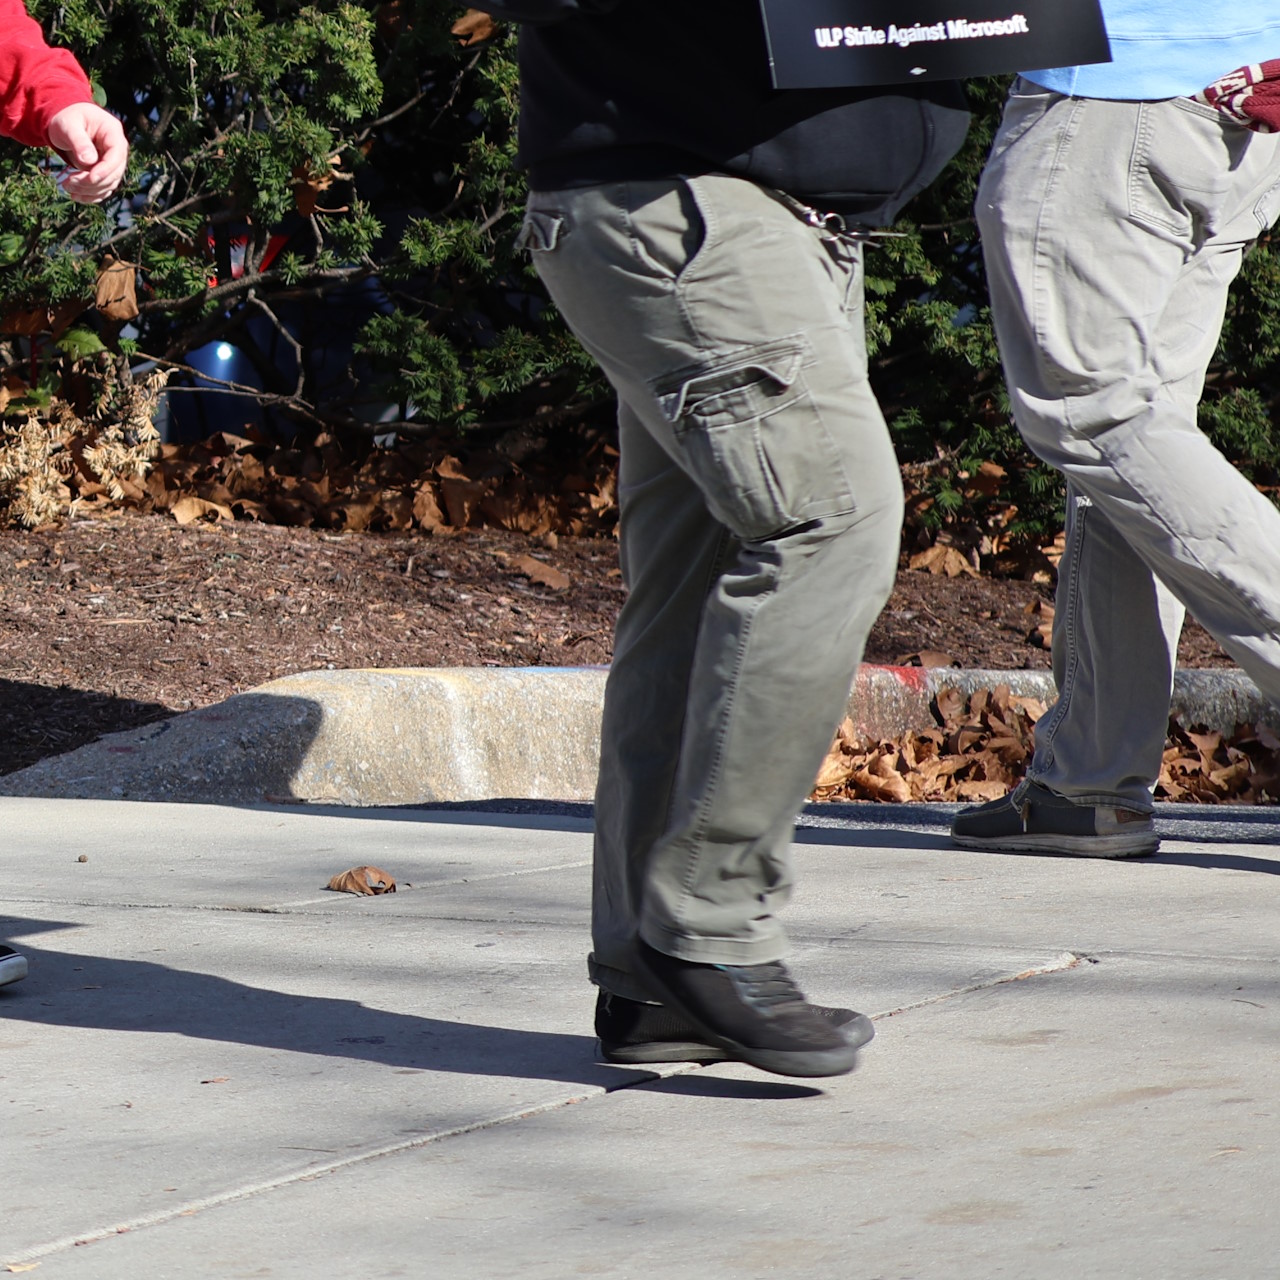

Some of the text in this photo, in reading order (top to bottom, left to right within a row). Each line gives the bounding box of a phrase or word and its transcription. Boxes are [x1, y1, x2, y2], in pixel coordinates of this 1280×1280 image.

[815, 14, 1030, 48] ULP Strike Against Microsoft
